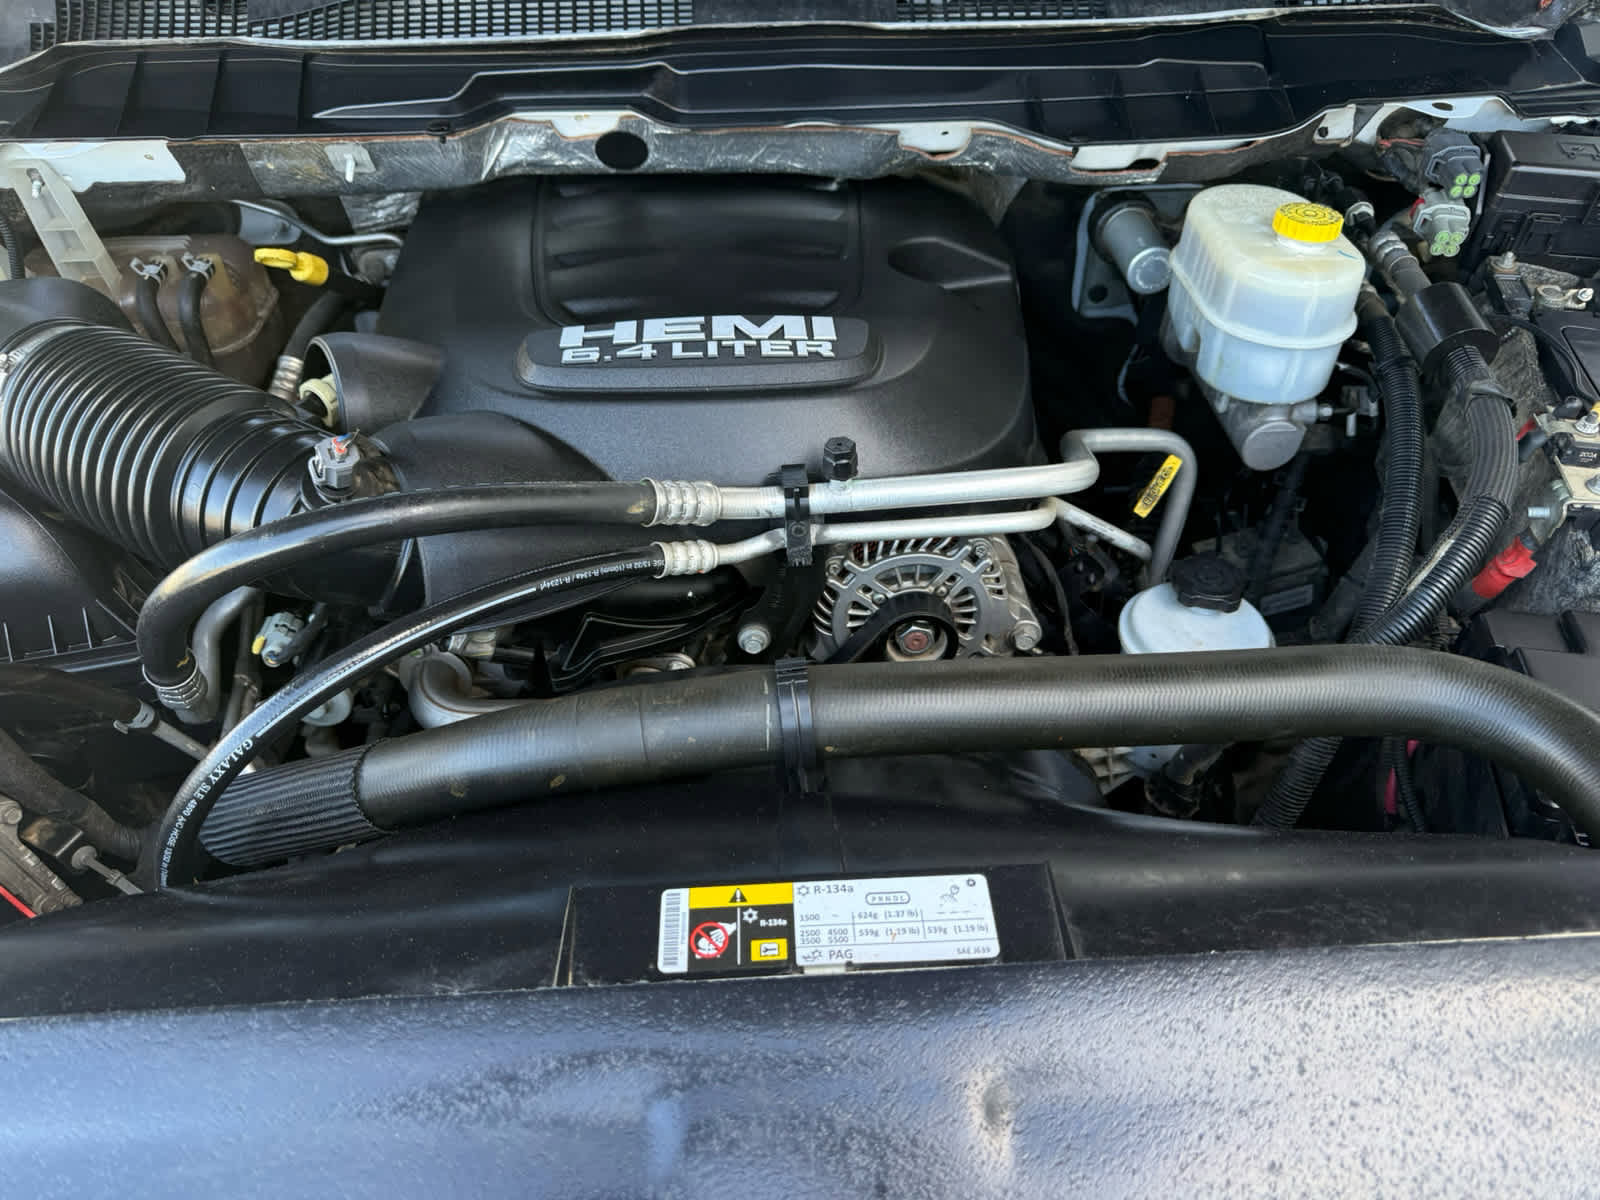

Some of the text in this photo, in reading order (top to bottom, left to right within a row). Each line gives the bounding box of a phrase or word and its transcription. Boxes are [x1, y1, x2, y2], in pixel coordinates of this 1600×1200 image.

[559, 314, 837, 348] HEMI
[560, 339, 836, 365] 6.4 LITER
[576, 568, 600, 580] R-134a
[540, 575, 571, 590] R-1234yf
[208, 738, 254, 784] GALAXY
[194, 782, 211, 800] SLE
[166, 828, 182, 848] HOSE
[814, 884, 854, 895] R-134a
[800, 913, 820, 922] 1500
[857, 911, 878, 920] 624g
[760, 918, 788, 928] R-134a
[800, 928, 848, 938] 2500 4500
[858, 928, 880, 938] 539g
[928, 925, 948, 936] 539g
[828, 936, 849, 944] 5500
[828, 949, 854, 960] PAG
[956, 946, 971, 955] SAE
